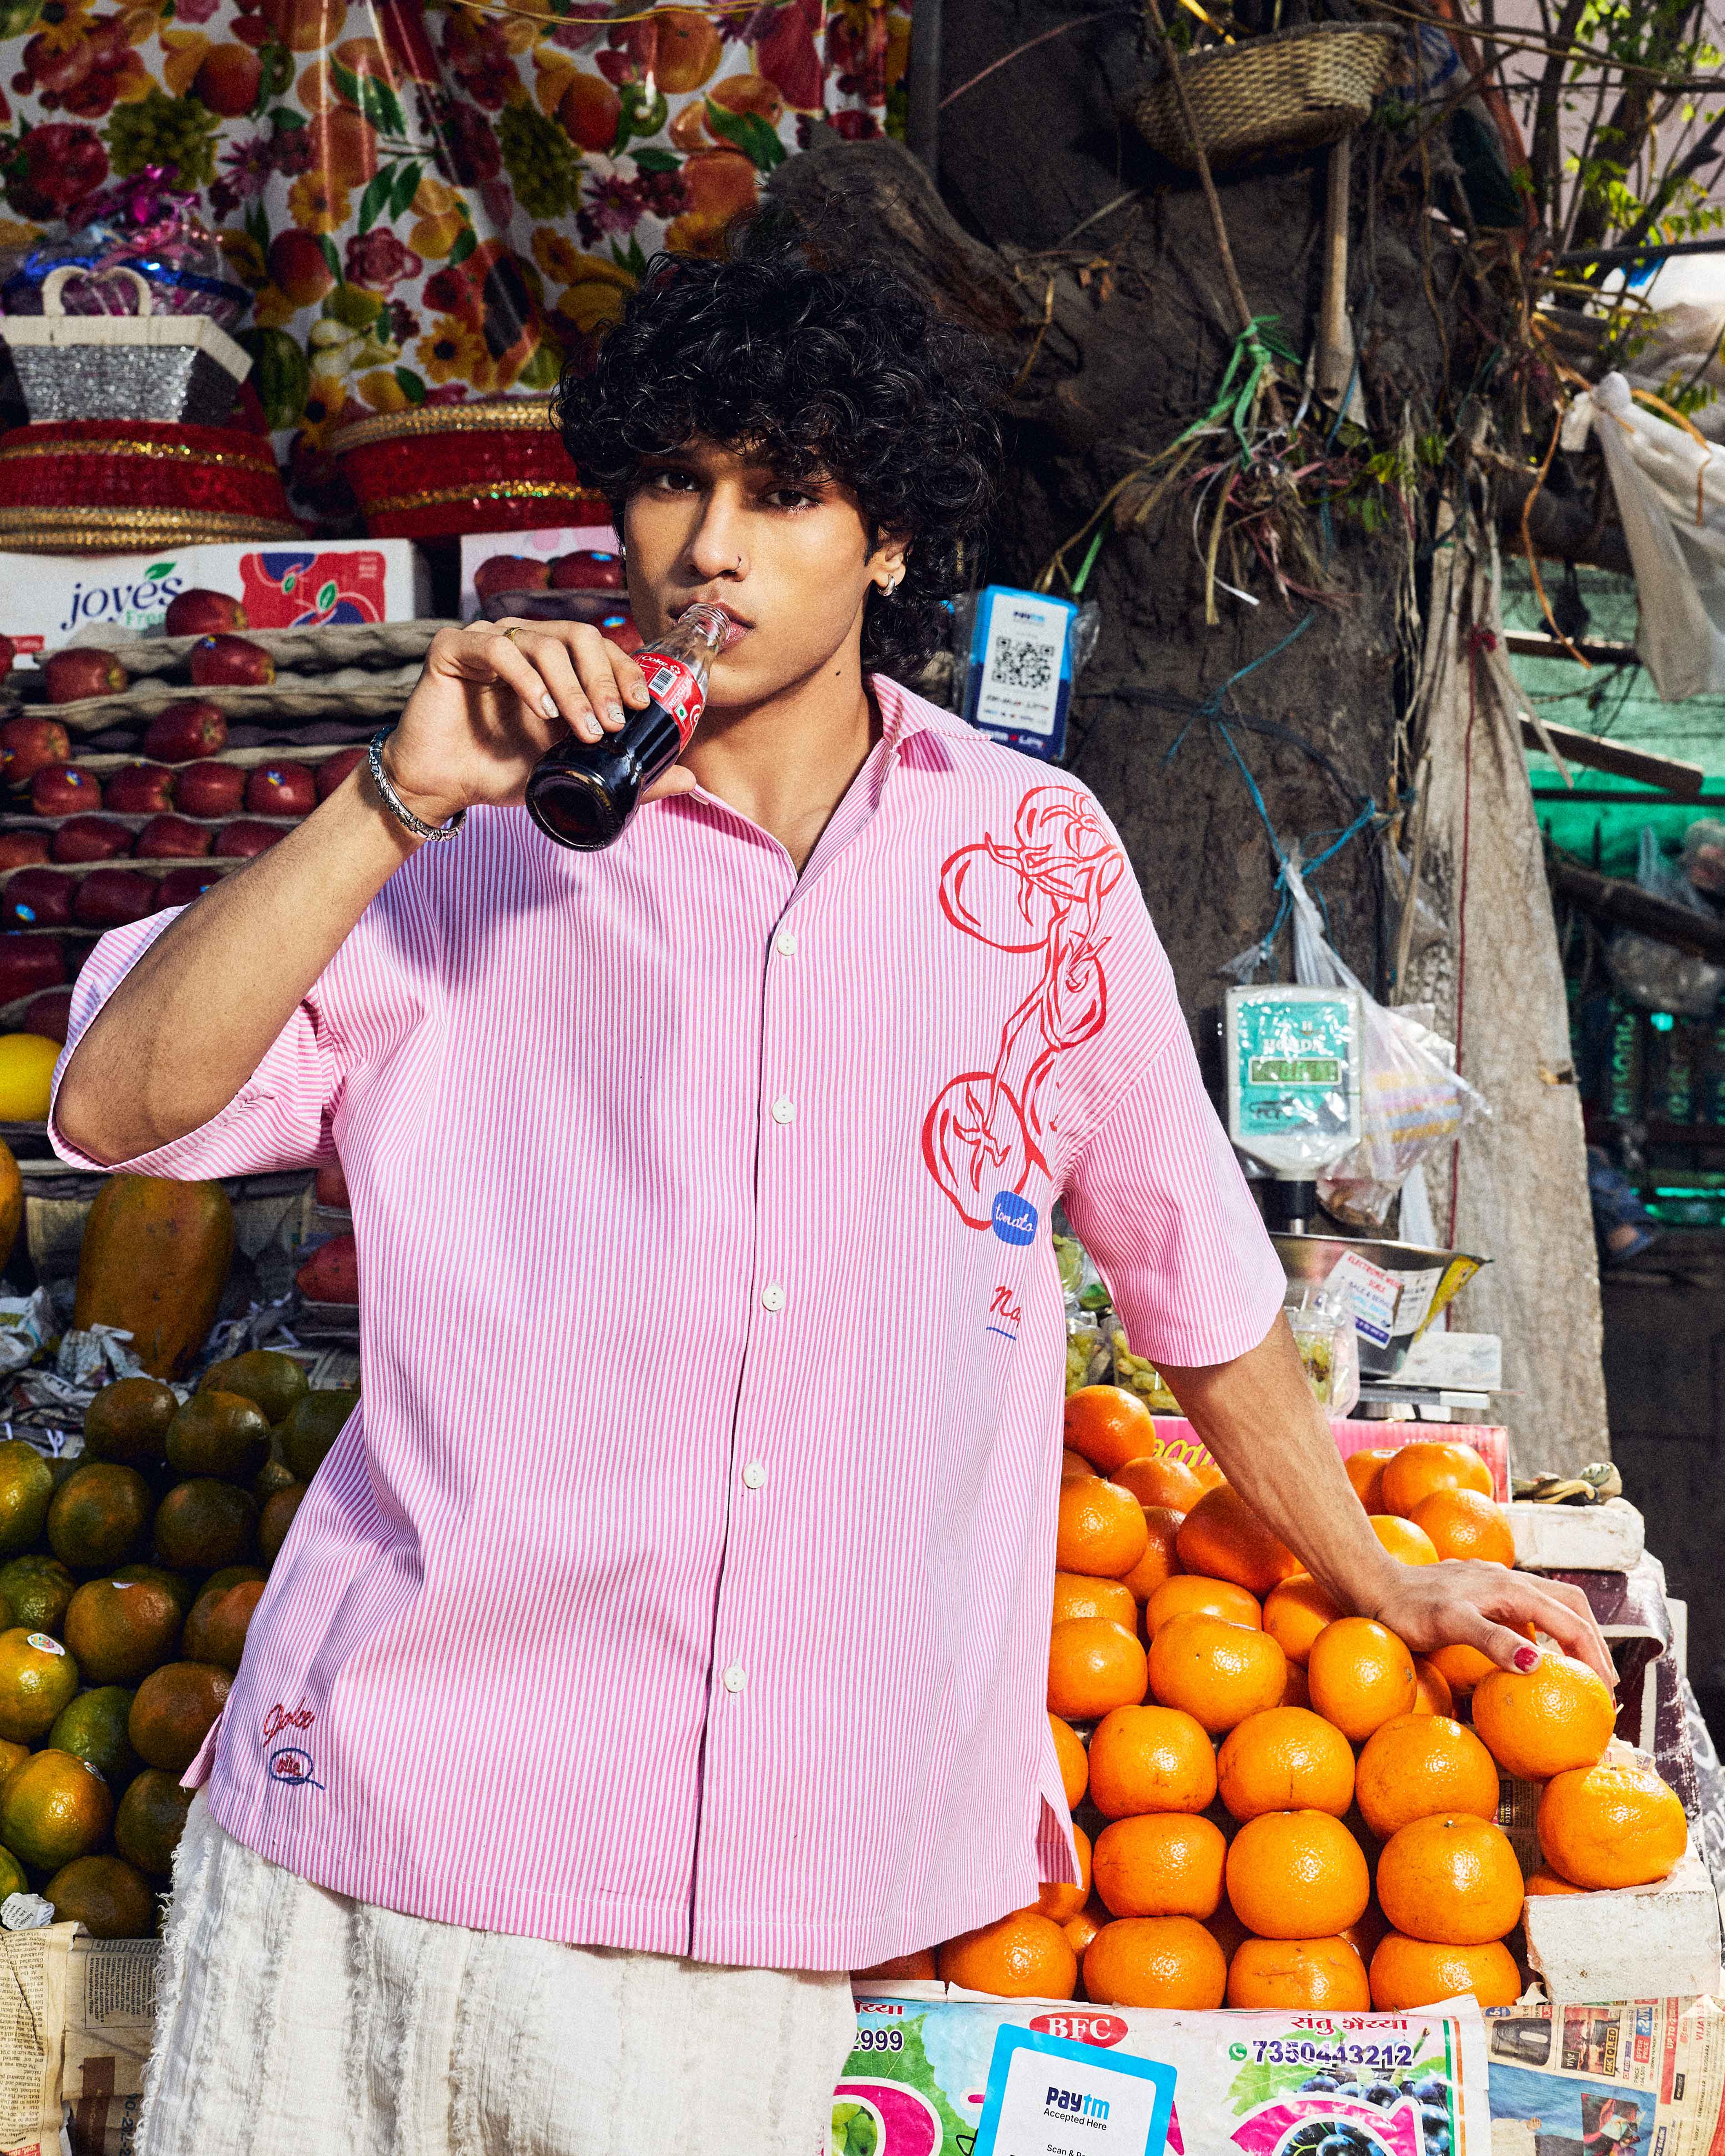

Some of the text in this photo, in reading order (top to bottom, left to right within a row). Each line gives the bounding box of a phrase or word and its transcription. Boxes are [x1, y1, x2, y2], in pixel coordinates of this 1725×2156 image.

[642, 655, 669, 666] Coke
[1047, 2018, 1111, 2040] BFC
[1666, 2026, 1675, 2049] UP TO
[1253, 2041, 1412, 2066] 7350443212
[1607, 2029, 1616, 2056] QLED
[1043, 2108, 1107, 2131] Accepted Here
[1047, 2144, 1067, 2156] Scan
